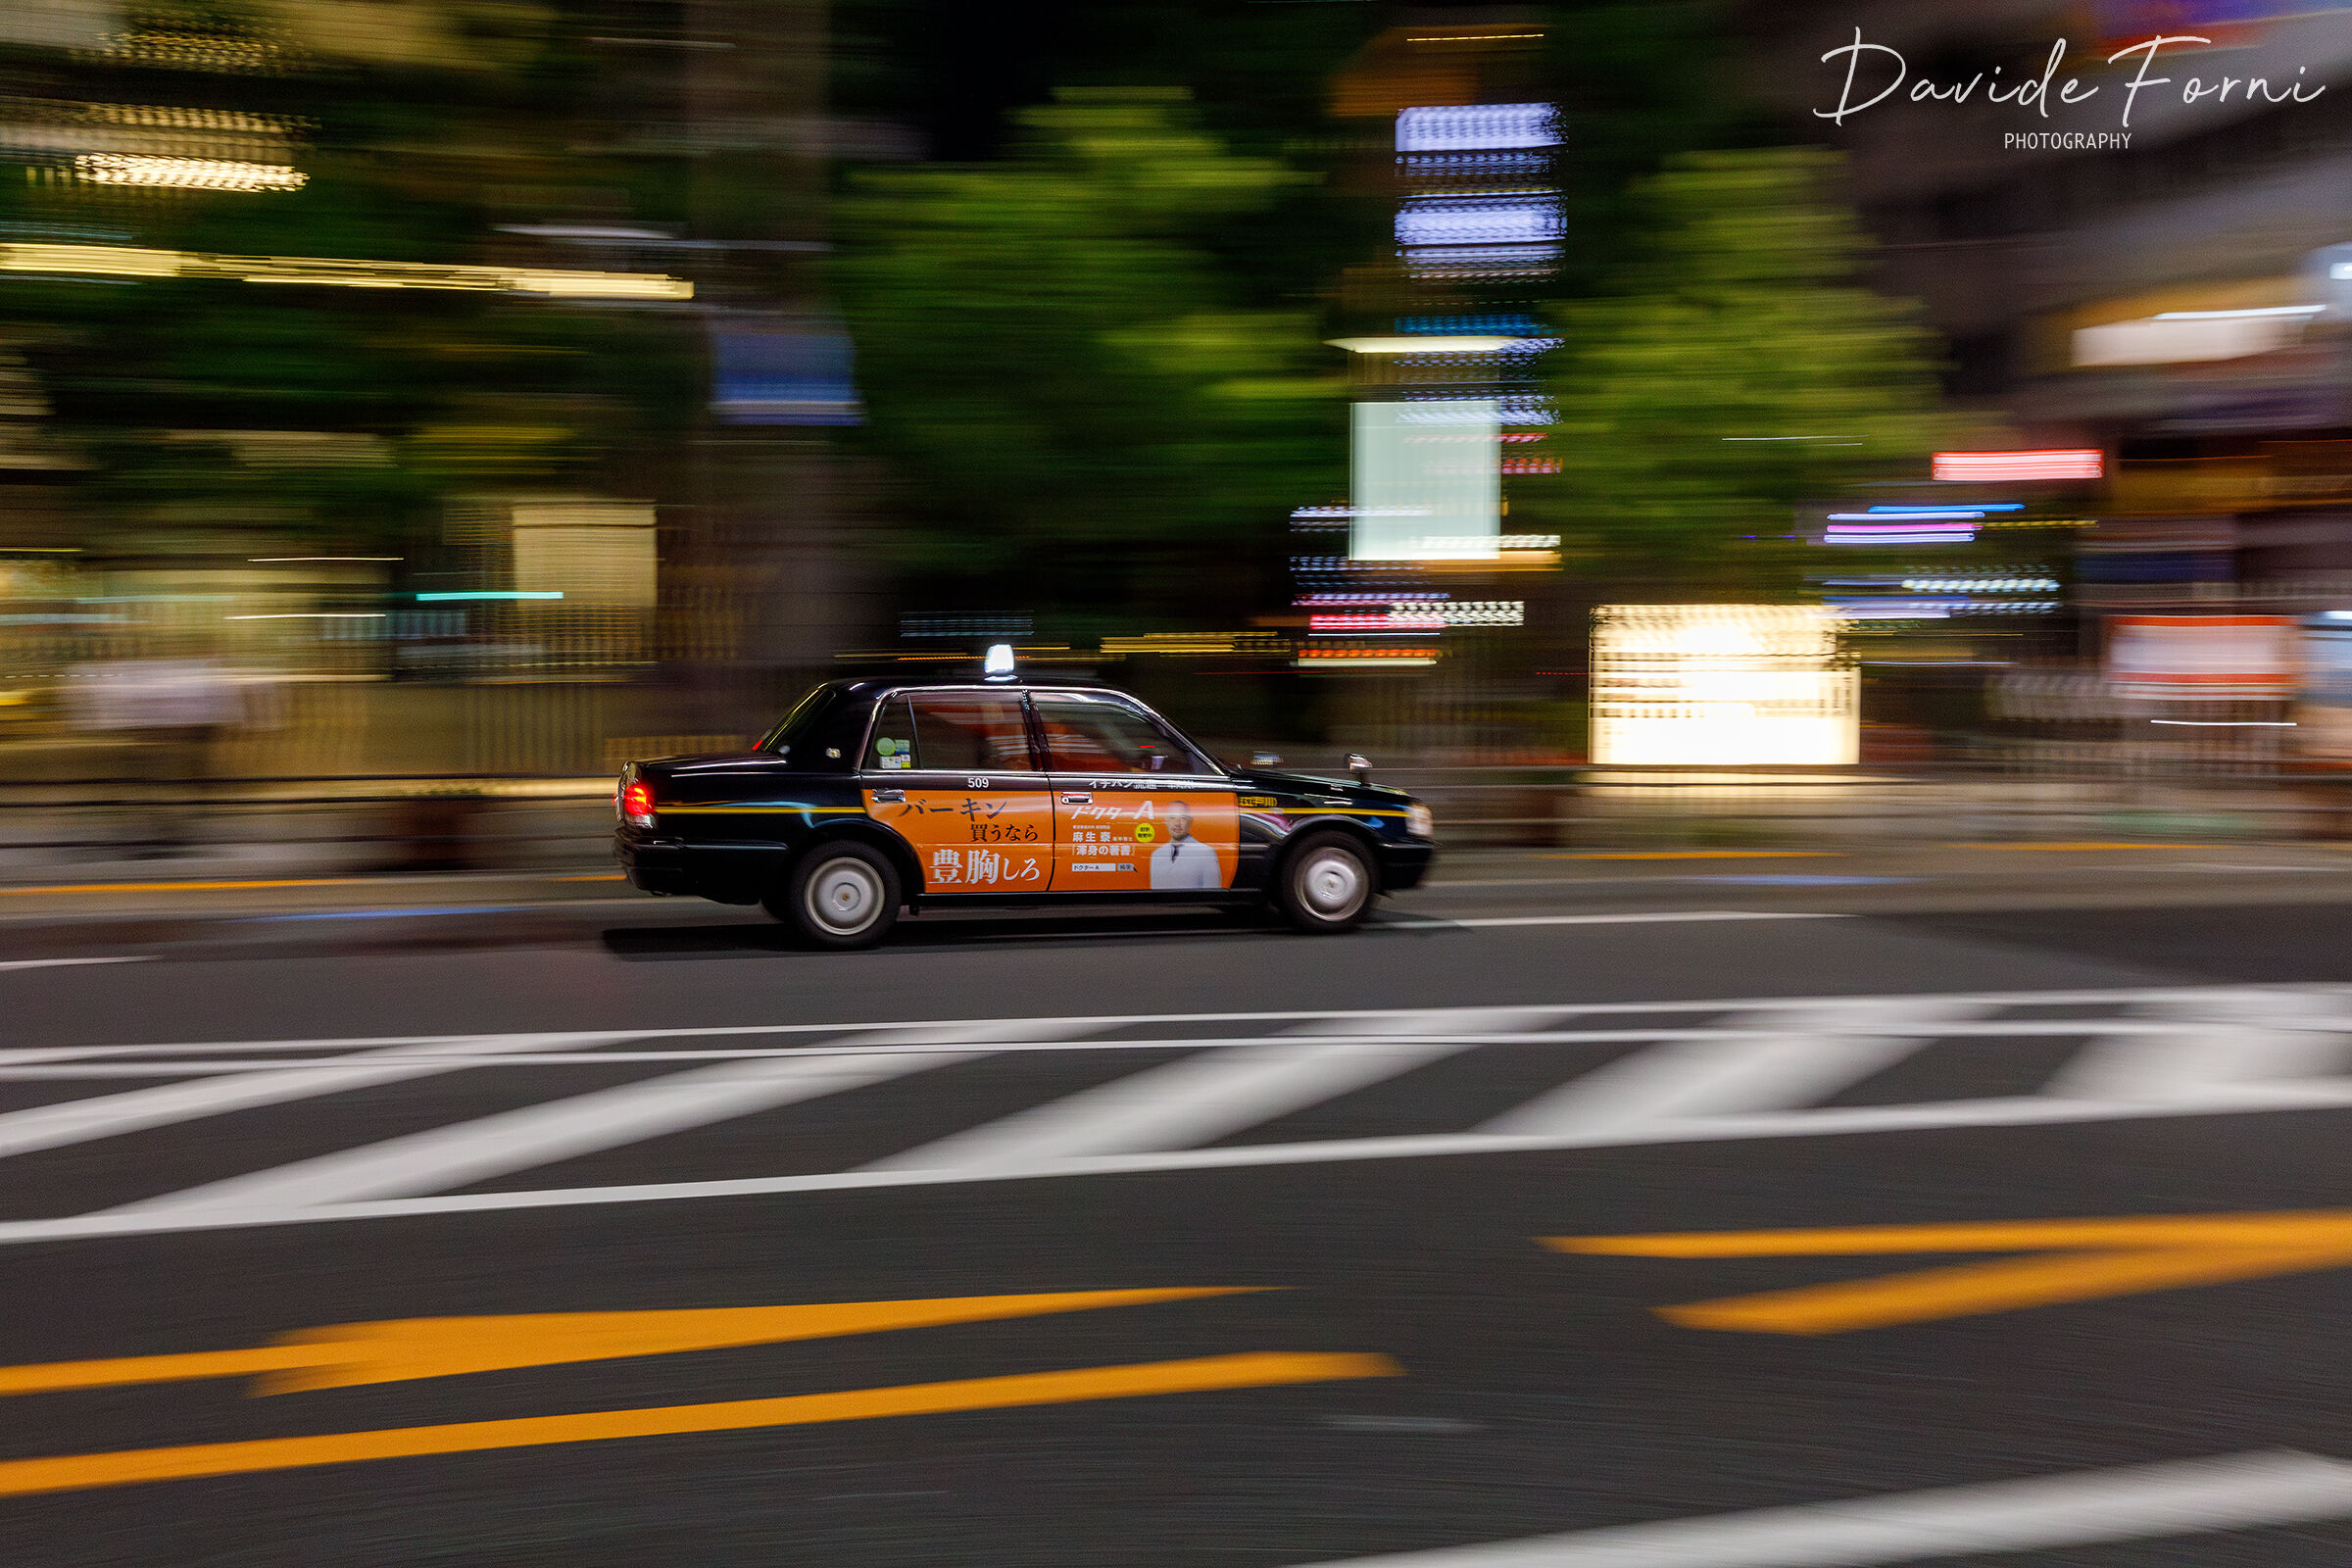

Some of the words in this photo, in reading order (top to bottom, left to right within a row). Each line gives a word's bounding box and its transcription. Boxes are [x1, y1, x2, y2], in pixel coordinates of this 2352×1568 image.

[967, 777, 990, 789] 509
[898, 798, 1008, 822] バーキン
[970, 823, 1039, 843] 買うなら
[928, 849, 1041, 885] 豊胸しろ
